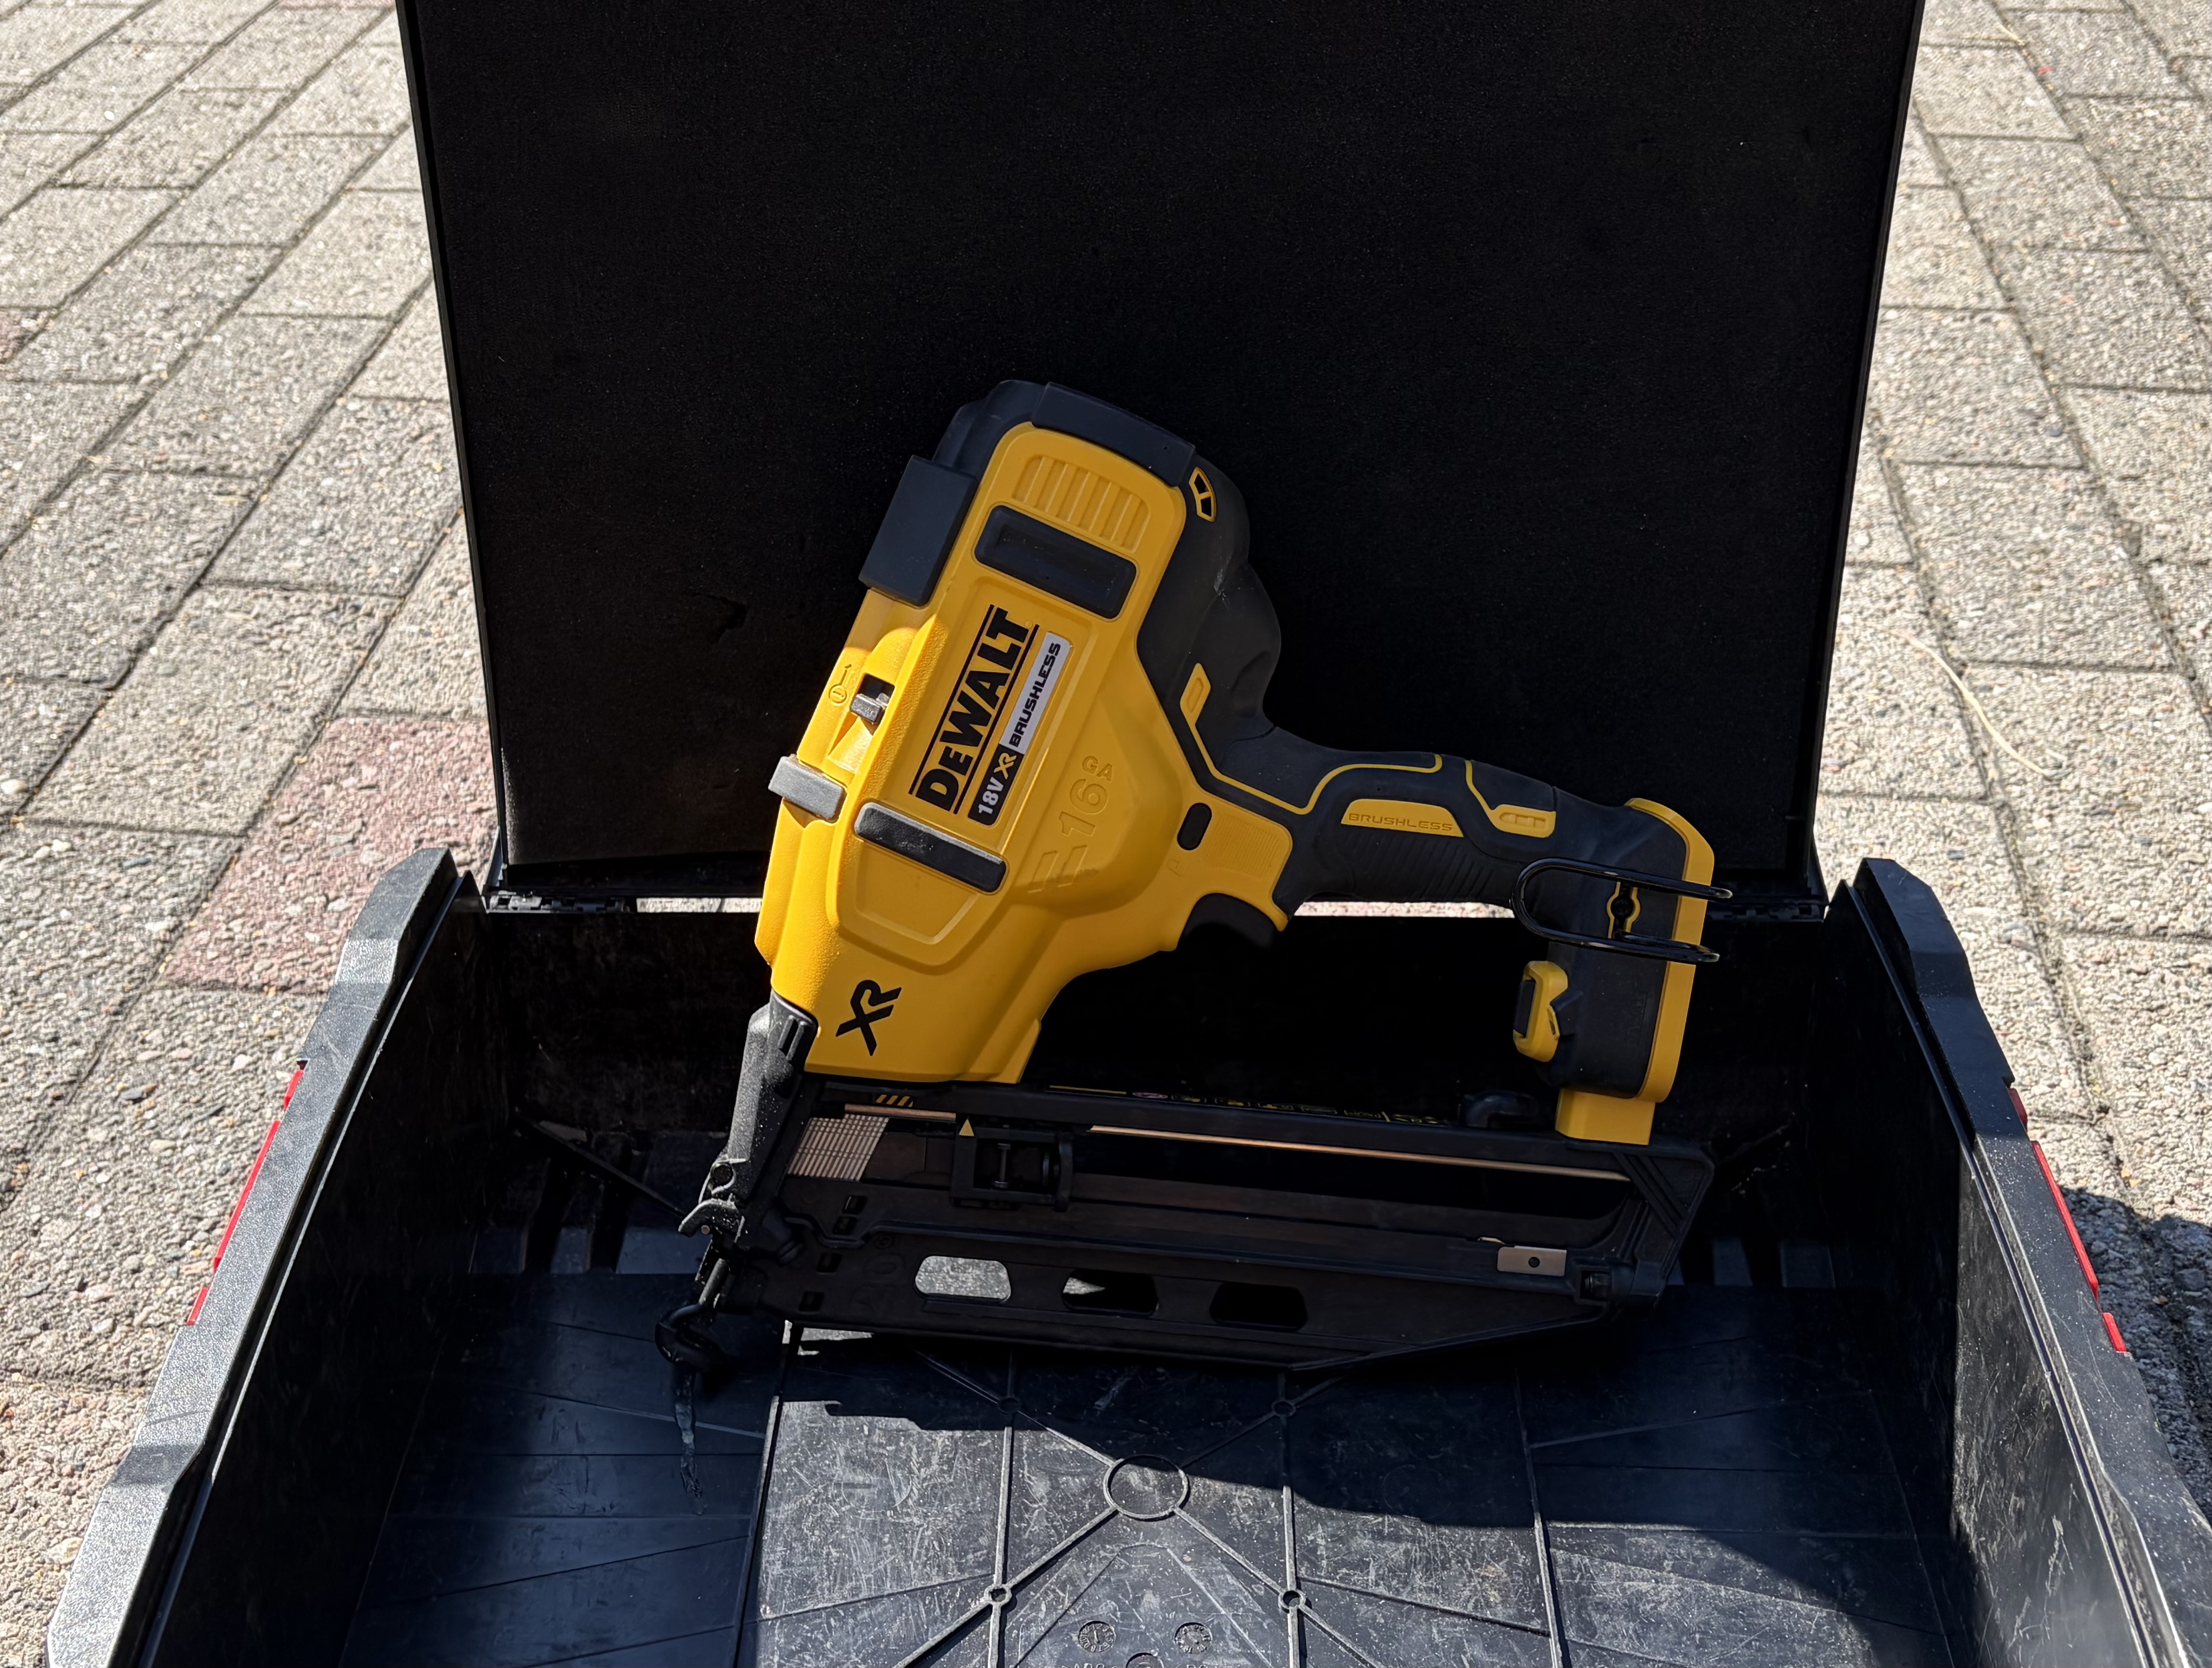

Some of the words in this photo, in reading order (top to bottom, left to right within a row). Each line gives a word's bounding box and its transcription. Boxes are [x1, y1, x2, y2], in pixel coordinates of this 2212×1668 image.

[915, 606, 1029, 812] DEWALT
[978, 776, 1004, 815] 18V
[993, 752, 1017, 780] XR
[1008, 642, 1061, 748] BRUSHLESS
[1081, 755, 1113, 782] GA
[1058, 778, 1108, 837] 16
[1348, 812, 1454, 832] BRUSHLESS
[835, 979, 902, 1057] XR
